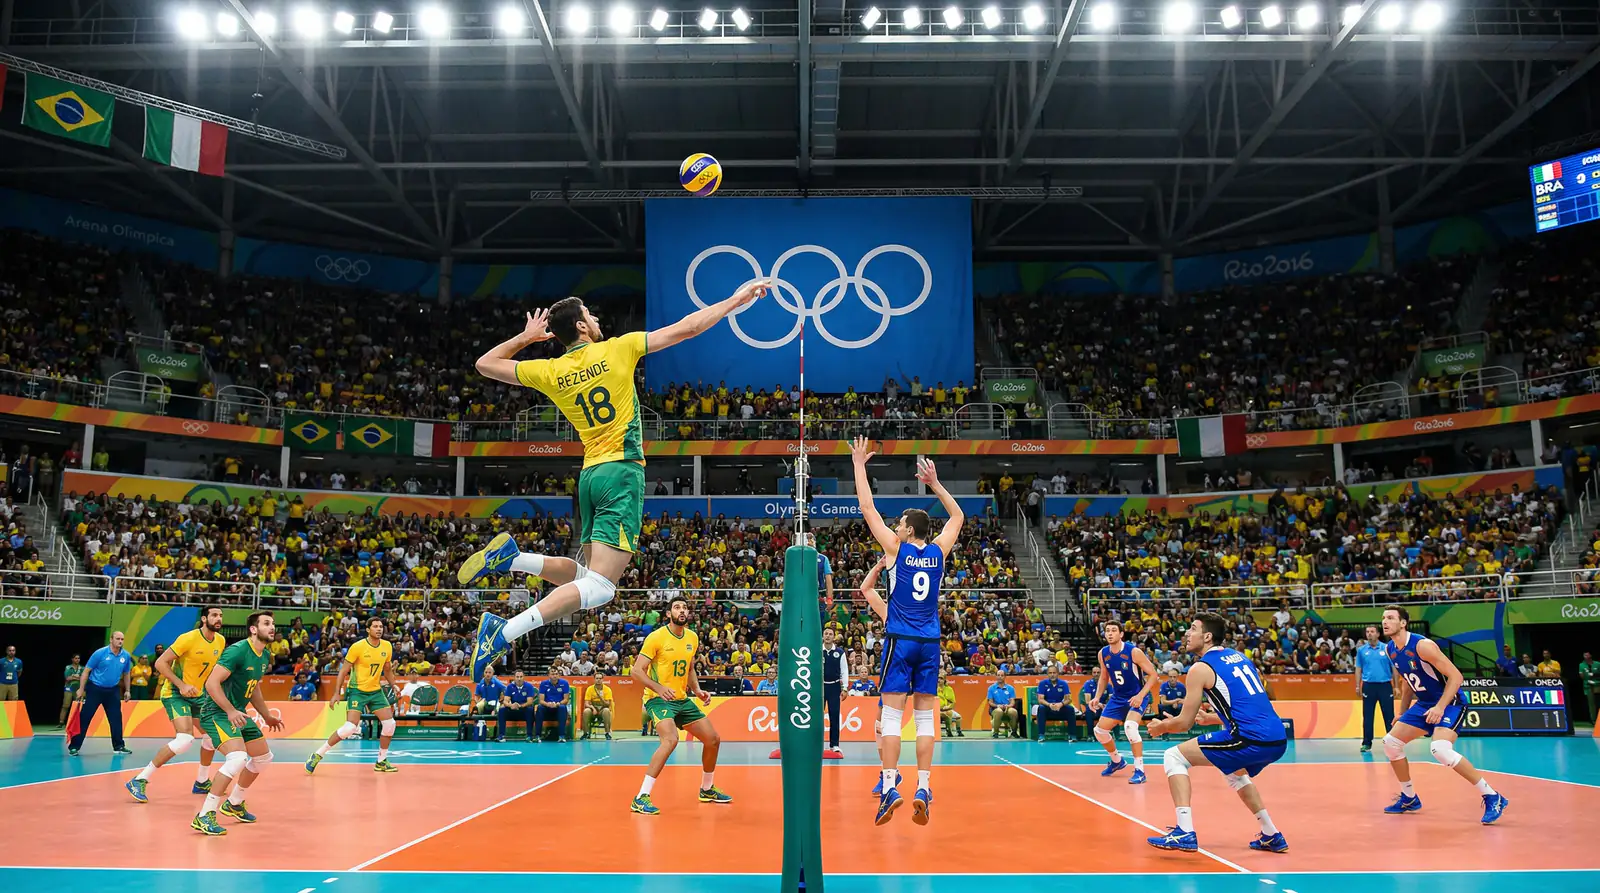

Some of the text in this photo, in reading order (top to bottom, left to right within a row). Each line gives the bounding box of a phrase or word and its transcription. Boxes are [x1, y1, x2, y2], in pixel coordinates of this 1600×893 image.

[1535, 180, 1564, 196] BRA
[65, 214, 108, 234] Arena
[1224, 250, 1314, 280] Rio2016
[147, 353, 187, 368] Rio2016
[1434, 349, 1476, 364] Rio2016
[557, 360, 610, 389] REZENDE
[993, 382, 1026, 391] Rio2016
[574, 386, 617, 428] 18
[1414, 418, 1454, 431] Rio2016
[528, 444, 562, 454] Rio2016
[1011, 443, 1045, 452] Rio2016
[912, 571, 930, 601] 9
[1, 604, 62, 620] Rio2016
[1561, 603, 1600, 618] Rio2
[198, 662, 210, 678] 7
[370, 664, 380, 677] 17
[673, 660, 687, 677] 13
[1114, 671, 1125, 685] 5
[1232, 664, 1264, 695] 11
[1404, 672, 1426, 692] 12
[1470, 679, 1498, 687] ONECA
[1535, 679, 1564, 687] ONECA
[789, 646, 811, 729] Rio2016
[1470, 691, 1500, 705] BRA
[1520, 691, 1544, 705] ITA
